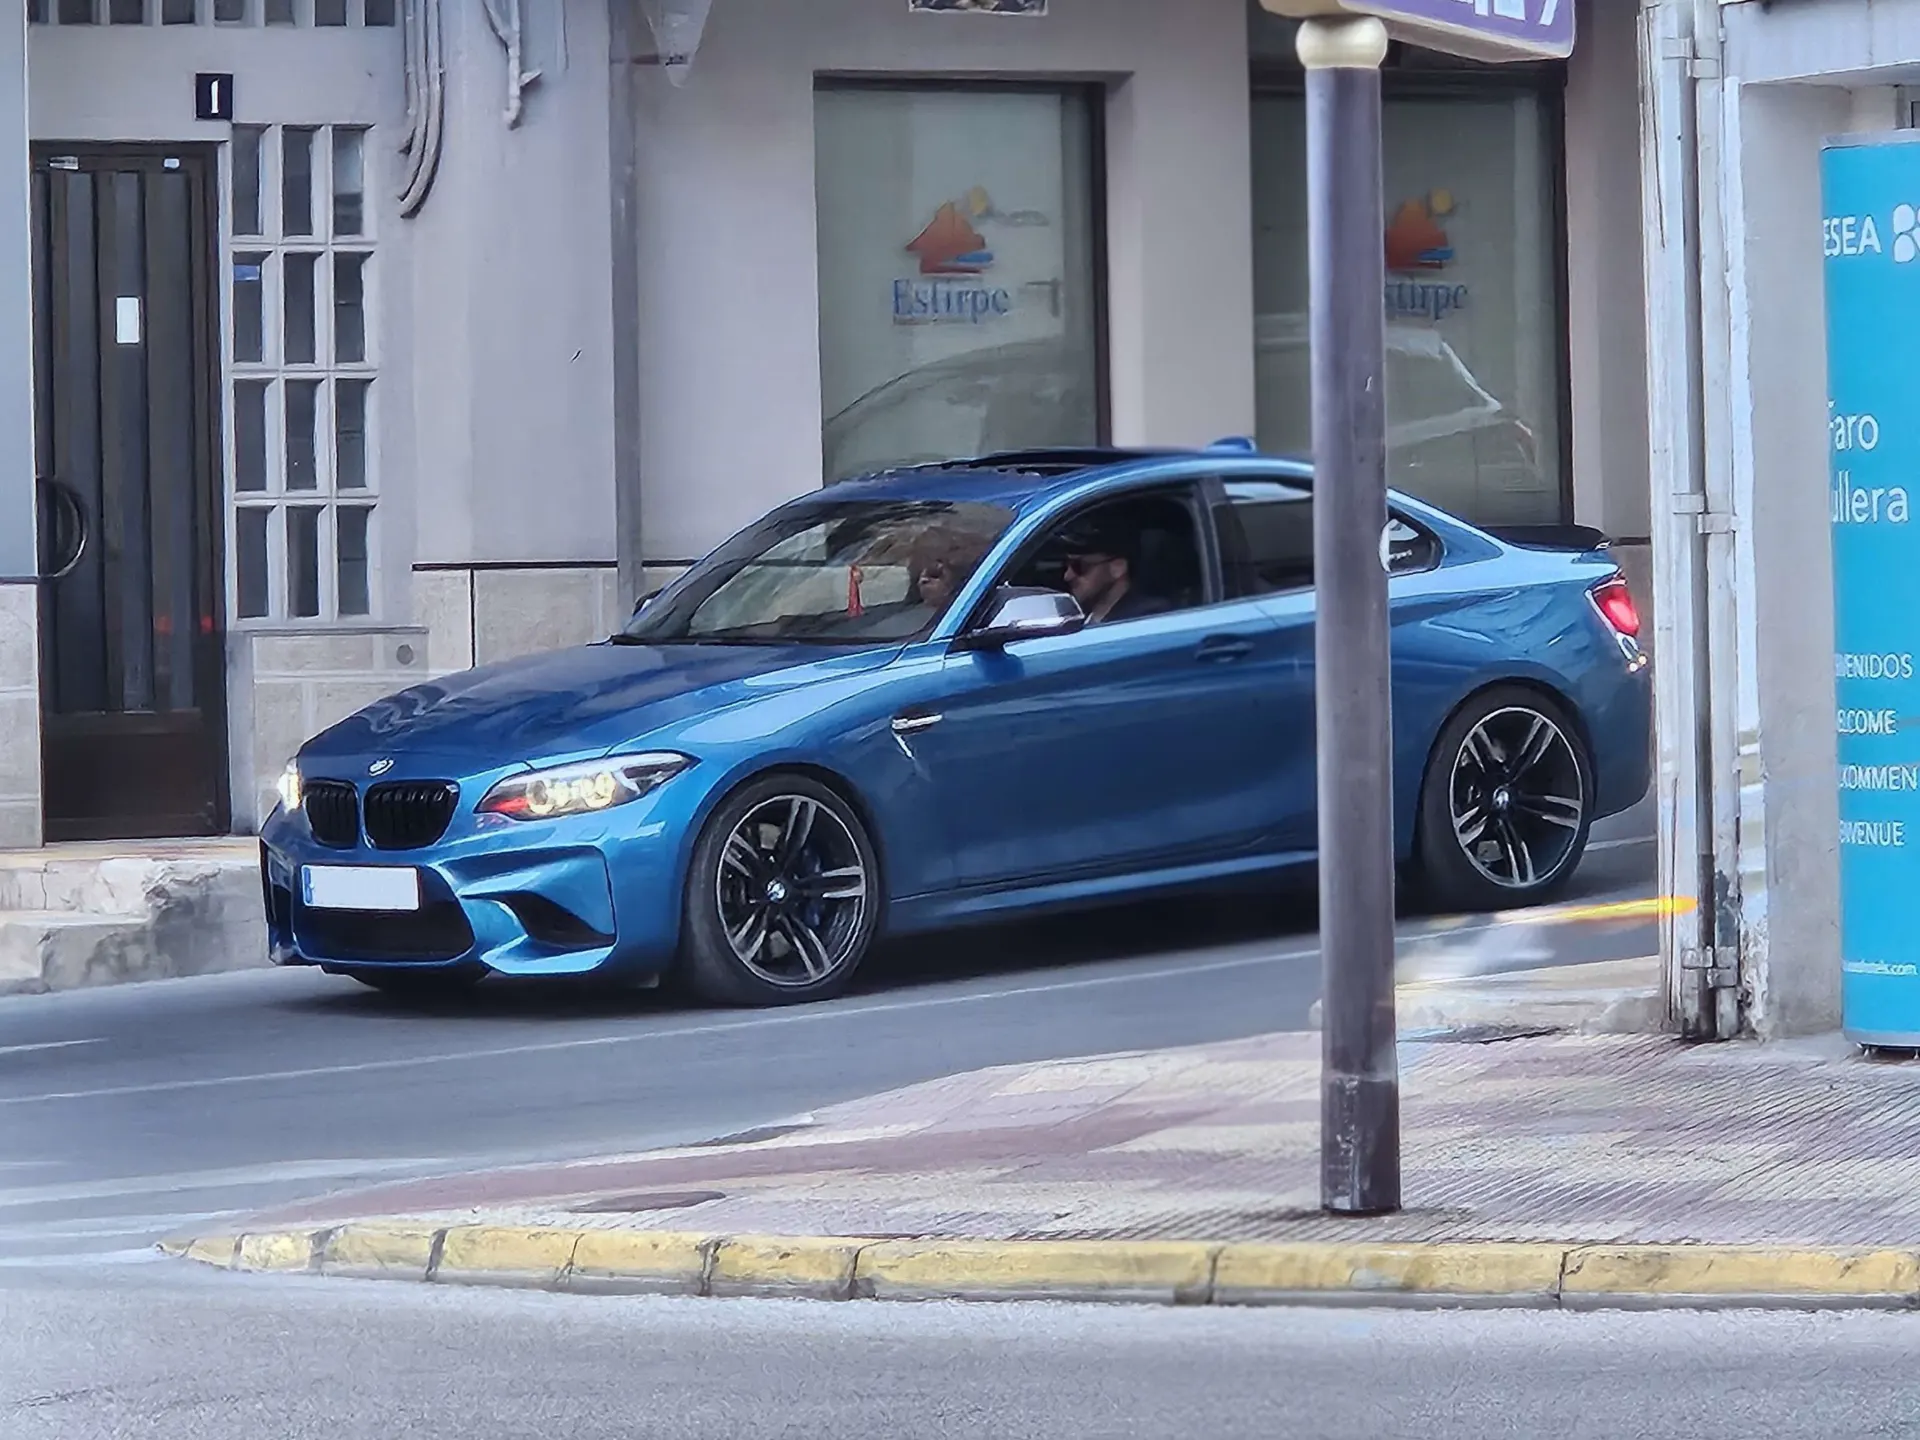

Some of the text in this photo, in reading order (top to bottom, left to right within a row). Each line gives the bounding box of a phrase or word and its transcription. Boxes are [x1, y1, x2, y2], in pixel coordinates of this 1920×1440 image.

[210, 79, 220, 114] 1
[893, 278, 1009, 324] Estirpe
[1829, 401, 1879, 451] aro
